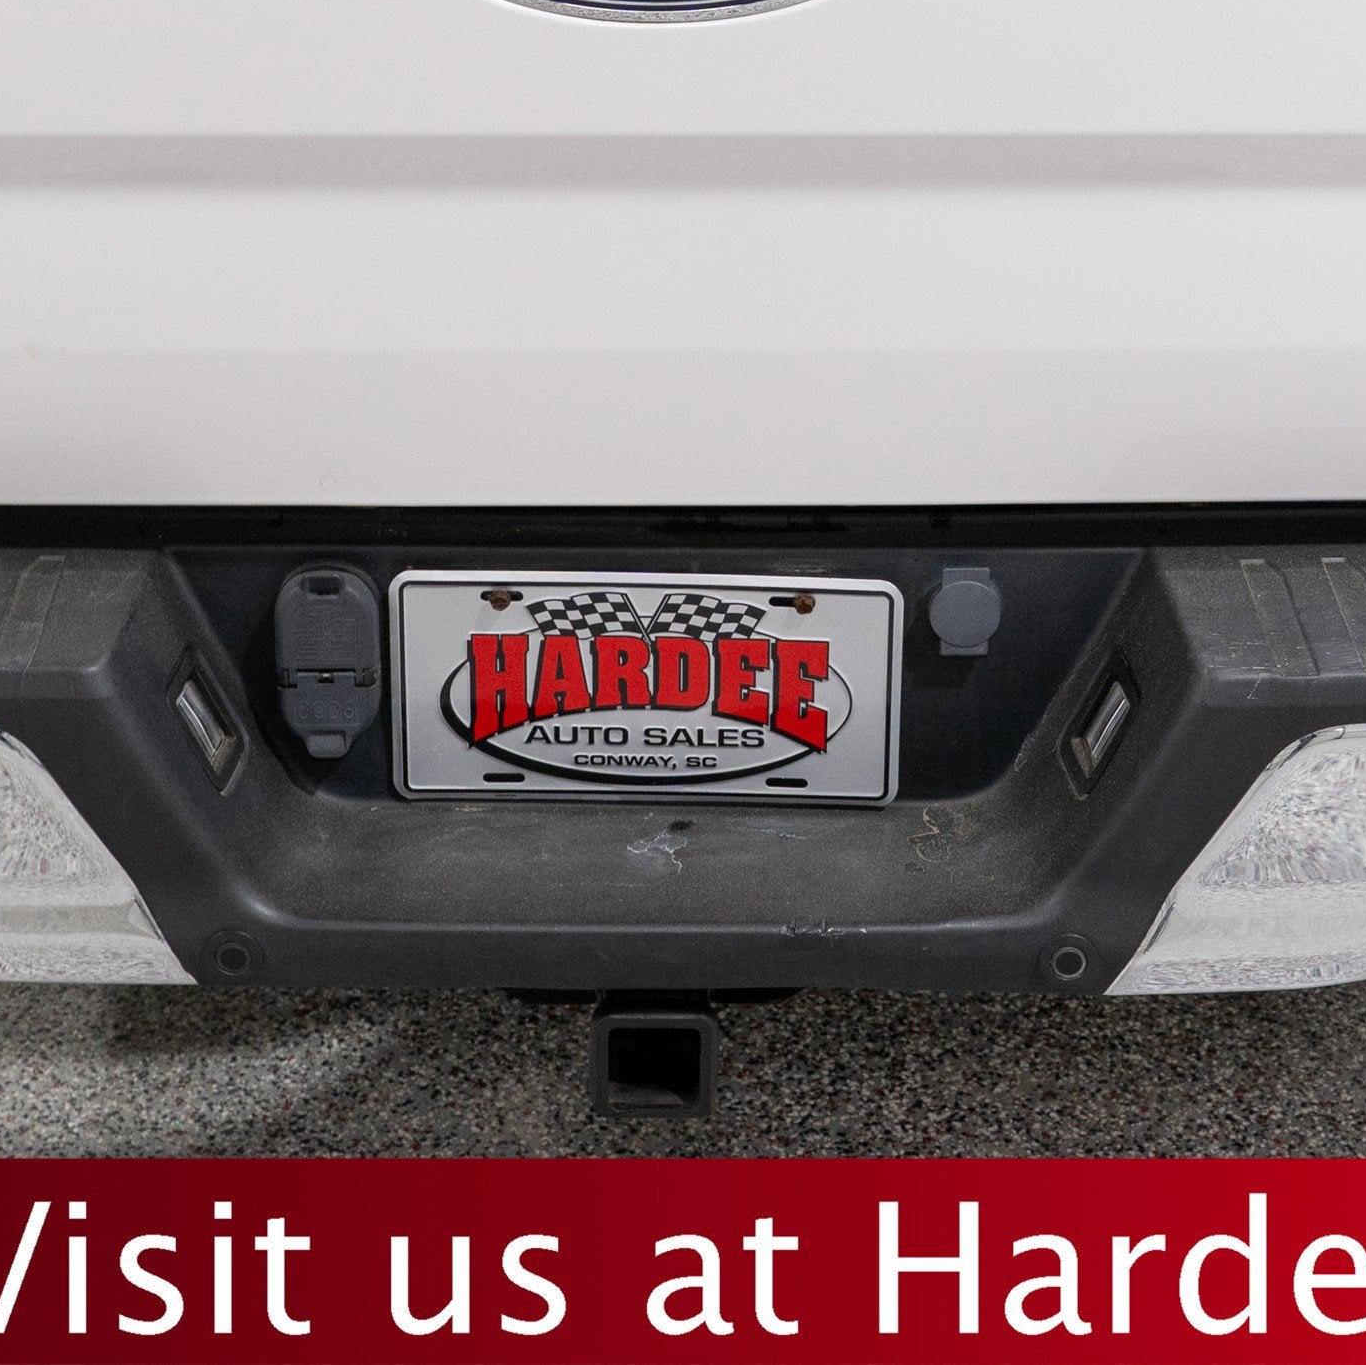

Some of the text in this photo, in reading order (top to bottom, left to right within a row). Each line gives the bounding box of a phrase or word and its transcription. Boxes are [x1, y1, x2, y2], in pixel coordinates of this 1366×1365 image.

[468, 633, 829, 752] HARDEE
[525, 725, 765, 748] AUTO SALES
[573, 754, 718, 770] CONWAY, SC
